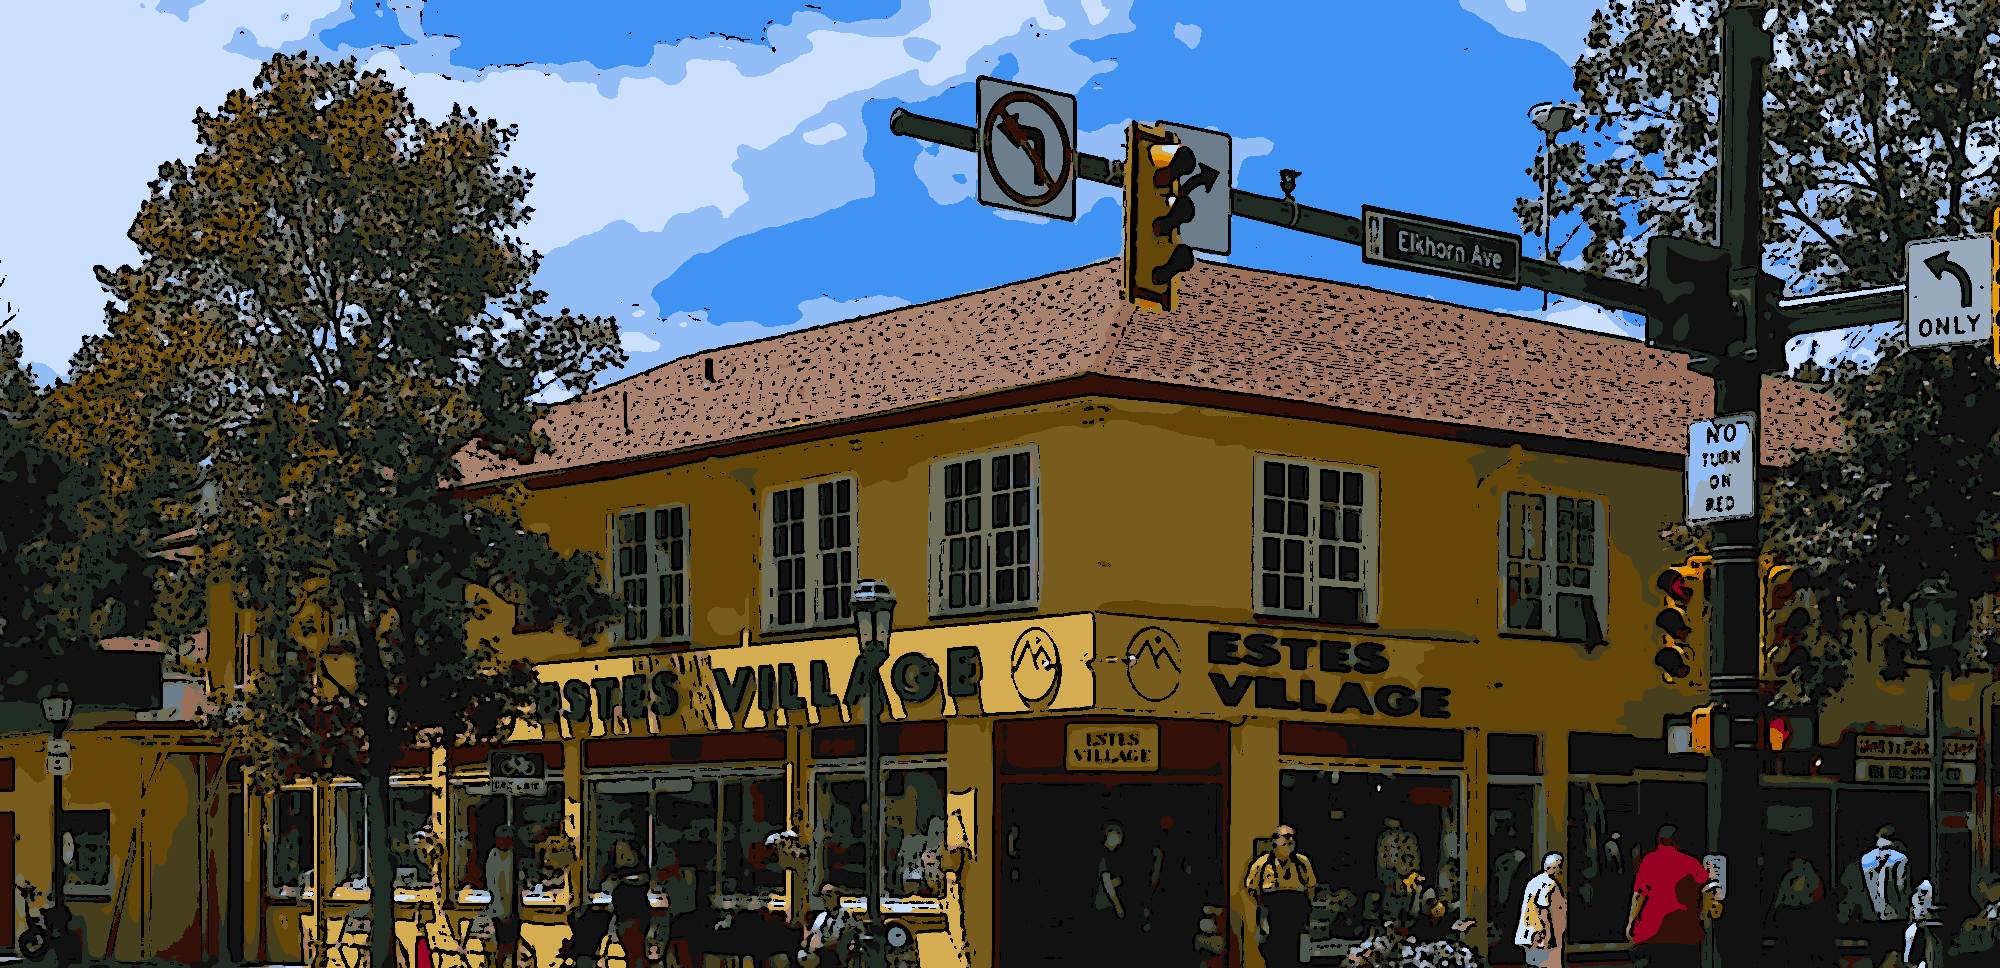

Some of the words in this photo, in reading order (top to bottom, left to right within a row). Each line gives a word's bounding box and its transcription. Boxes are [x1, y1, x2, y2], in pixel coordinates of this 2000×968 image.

[1398, 230, 1466, 263] Elkhorn
[1470, 243, 1503, 270] Ave
[1918, 313, 1981, 338] ONLY
[1706, 423, 1737, 444] NO
[1702, 449, 1741, 468] TURN
[1709, 473, 1732, 491] ON
[1705, 495, 1735, 513] RED
[1207, 630, 1390, 675] ESTES
[535, 670, 681, 724] ESTES
[1207, 671, 1452, 719] VILLAGE
[1086, 732, 1140, 747] ESTES
[1073, 748, 1152, 763] VILLAGE
